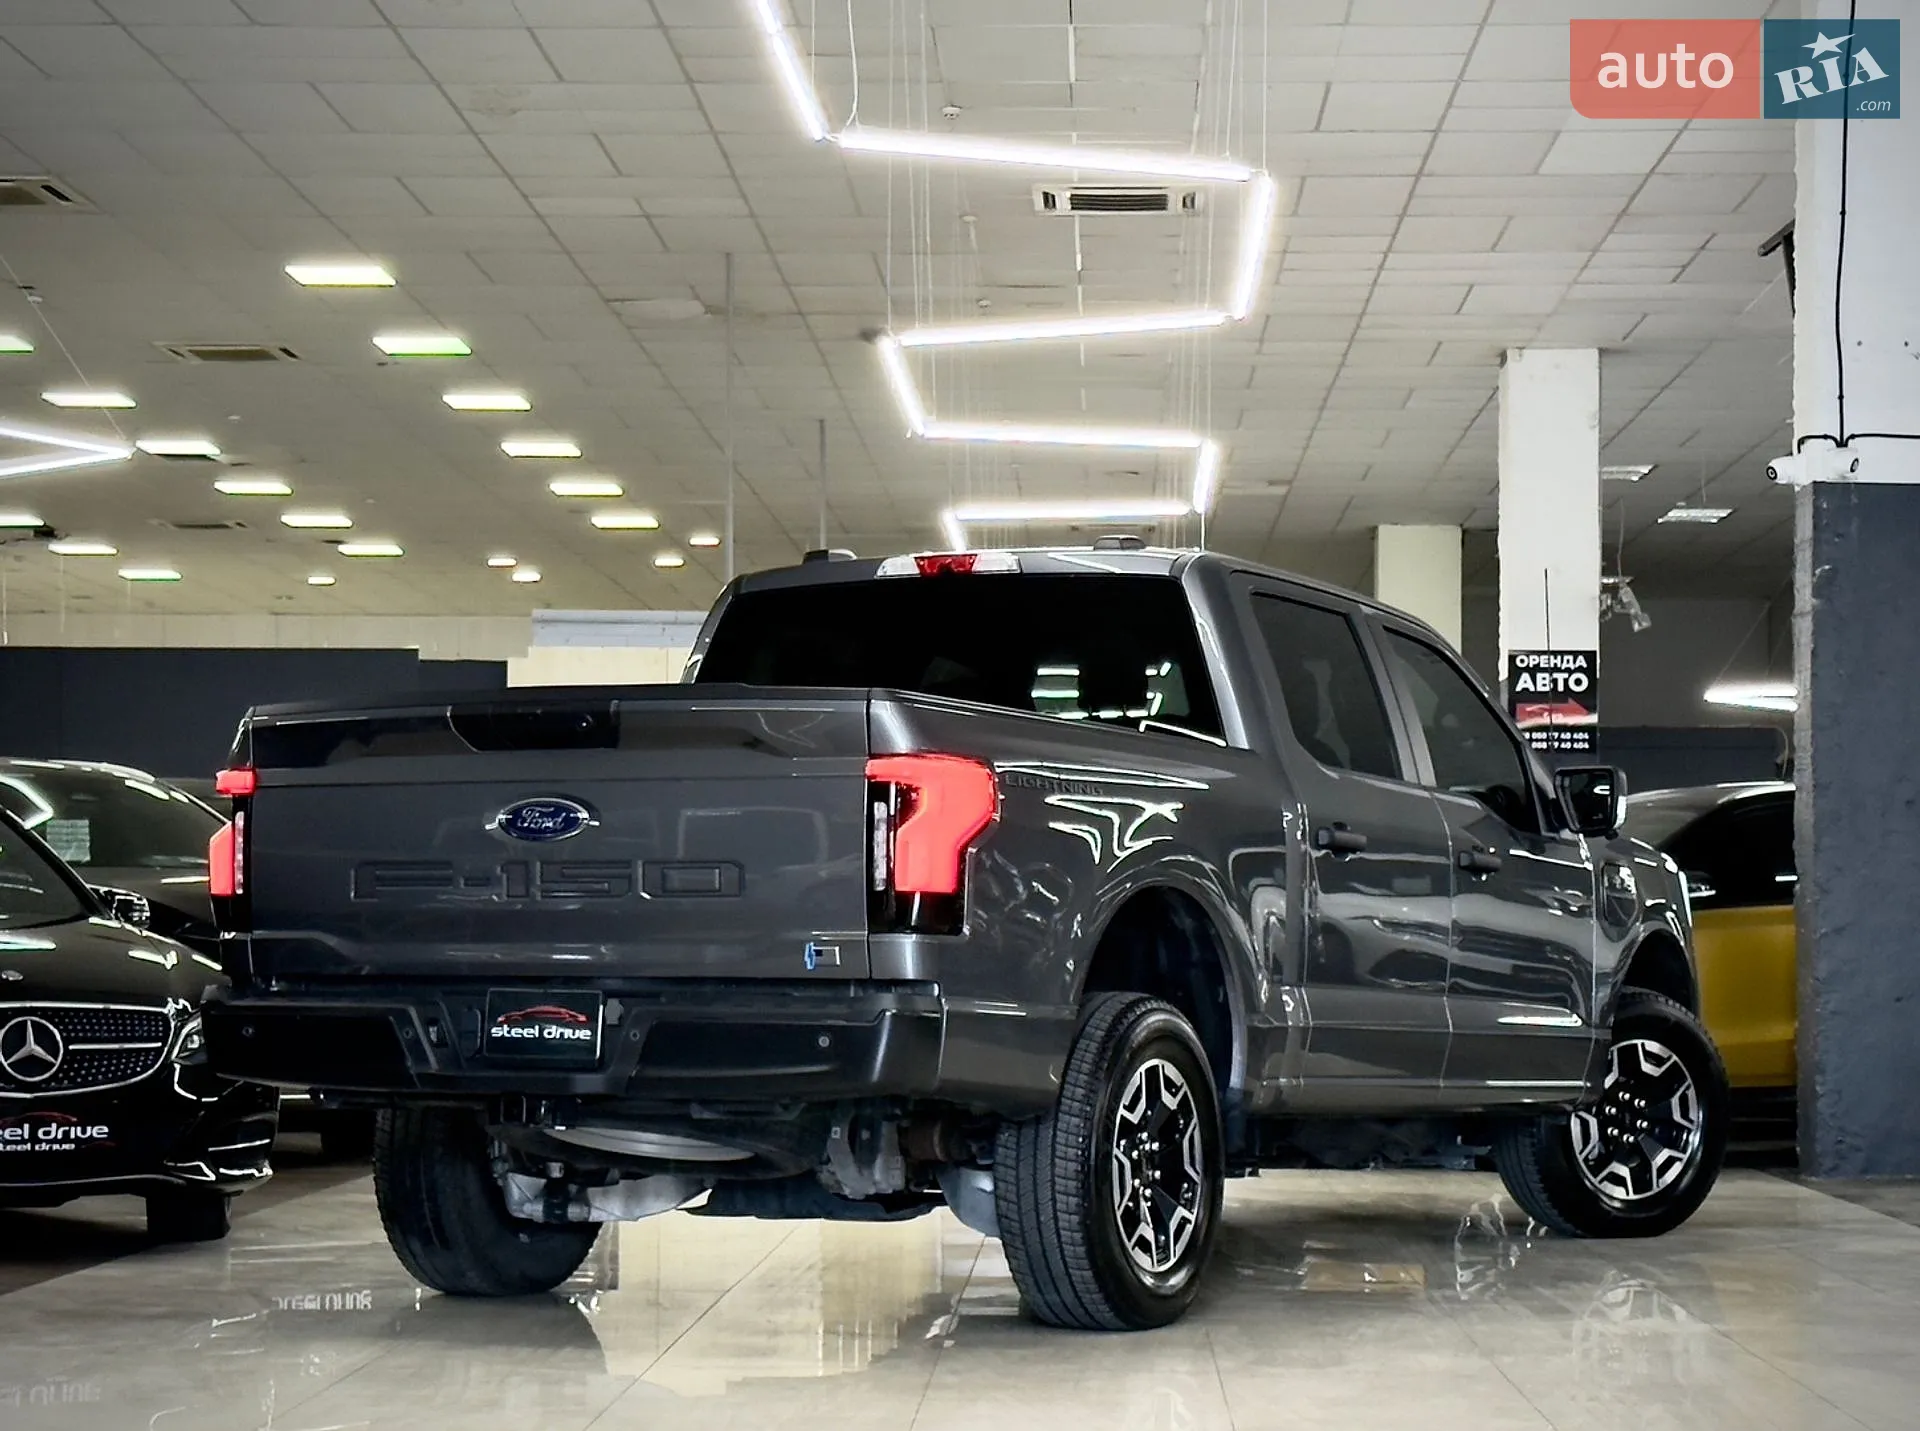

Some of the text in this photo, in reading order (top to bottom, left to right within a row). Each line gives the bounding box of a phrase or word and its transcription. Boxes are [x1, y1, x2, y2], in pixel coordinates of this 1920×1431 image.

[1515, 654, 1588, 670] ОРЕНДА
[1515, 672, 1589, 693] АВТО
[1005, 774, 1104, 796] LIGHTNING
[517, 806, 566, 830] Ford
[351, 859, 746, 902] F-150
[490, 1024, 593, 1040] steel drive
[37, 1122, 109, 1140] drive
[35, 1141, 76, 1151] drive
